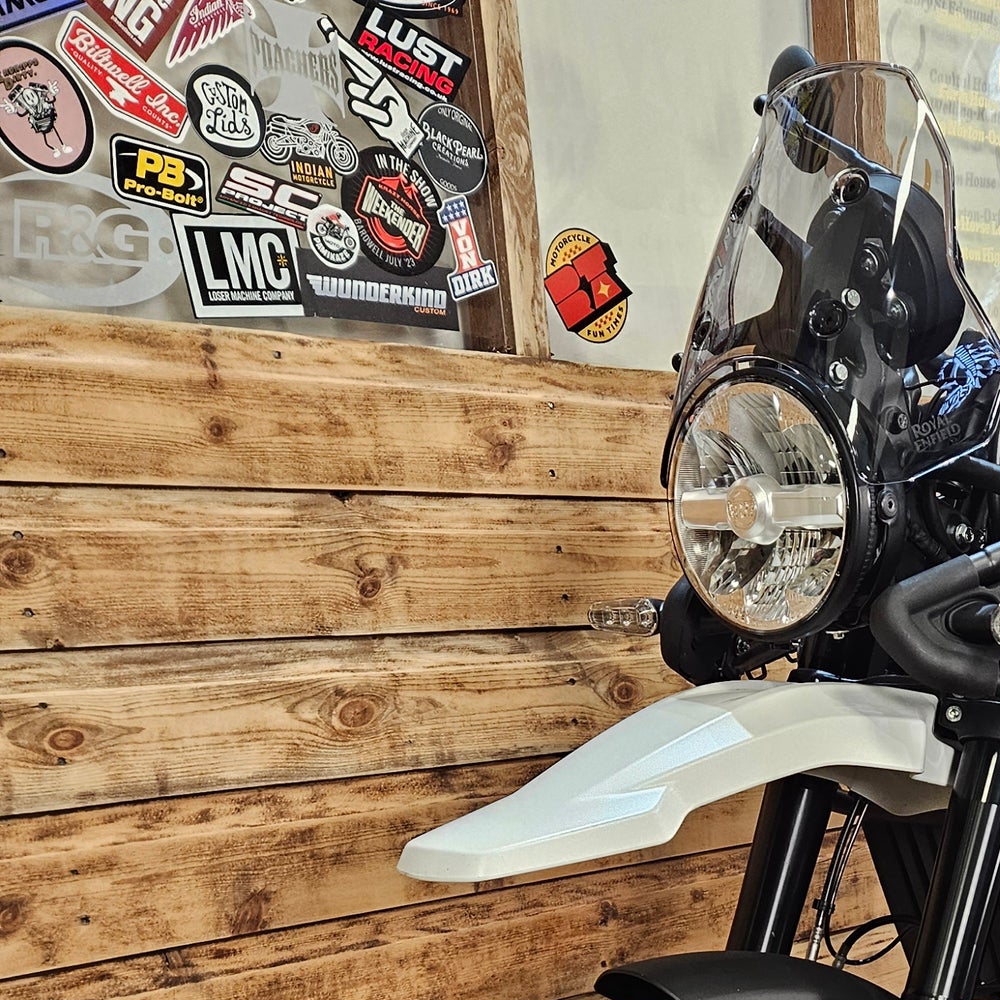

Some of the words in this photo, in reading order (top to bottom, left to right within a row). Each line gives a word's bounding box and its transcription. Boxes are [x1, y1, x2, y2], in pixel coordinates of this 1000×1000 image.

[365, 7, 463, 76] LUST
[68, 28, 150, 95] Biltwell
[357, 29, 455, 95] RACING
[201, 81, 249, 117] CUSTOM
[136, 148, 186, 189] PB
[290, 160, 334, 180] INDIAN
[292, 173, 335, 188] MOTORCYCLE
[374, 153, 389, 170] IN
[389, 154, 411, 178] THE
[409, 169, 438, 208] SHOW
[220, 187, 308, 222] PROJECT
[224, 166, 321, 217] SC
[361, 181, 427, 253] WEEKENDER
[193, 228, 290, 291] LMC
[550, 233, 592, 267] MOTORCYCLE
[306, 273, 447, 309] WUNDERKIND
[452, 264, 496, 294] DIRK
[414, 305, 447, 316] CUSTOM
[586, 328, 605, 338] FUN
[606, 305, 624, 334] TIMES
[911, 414, 953, 439] ROYAL
[913, 423, 962, 452] ENFIELD
